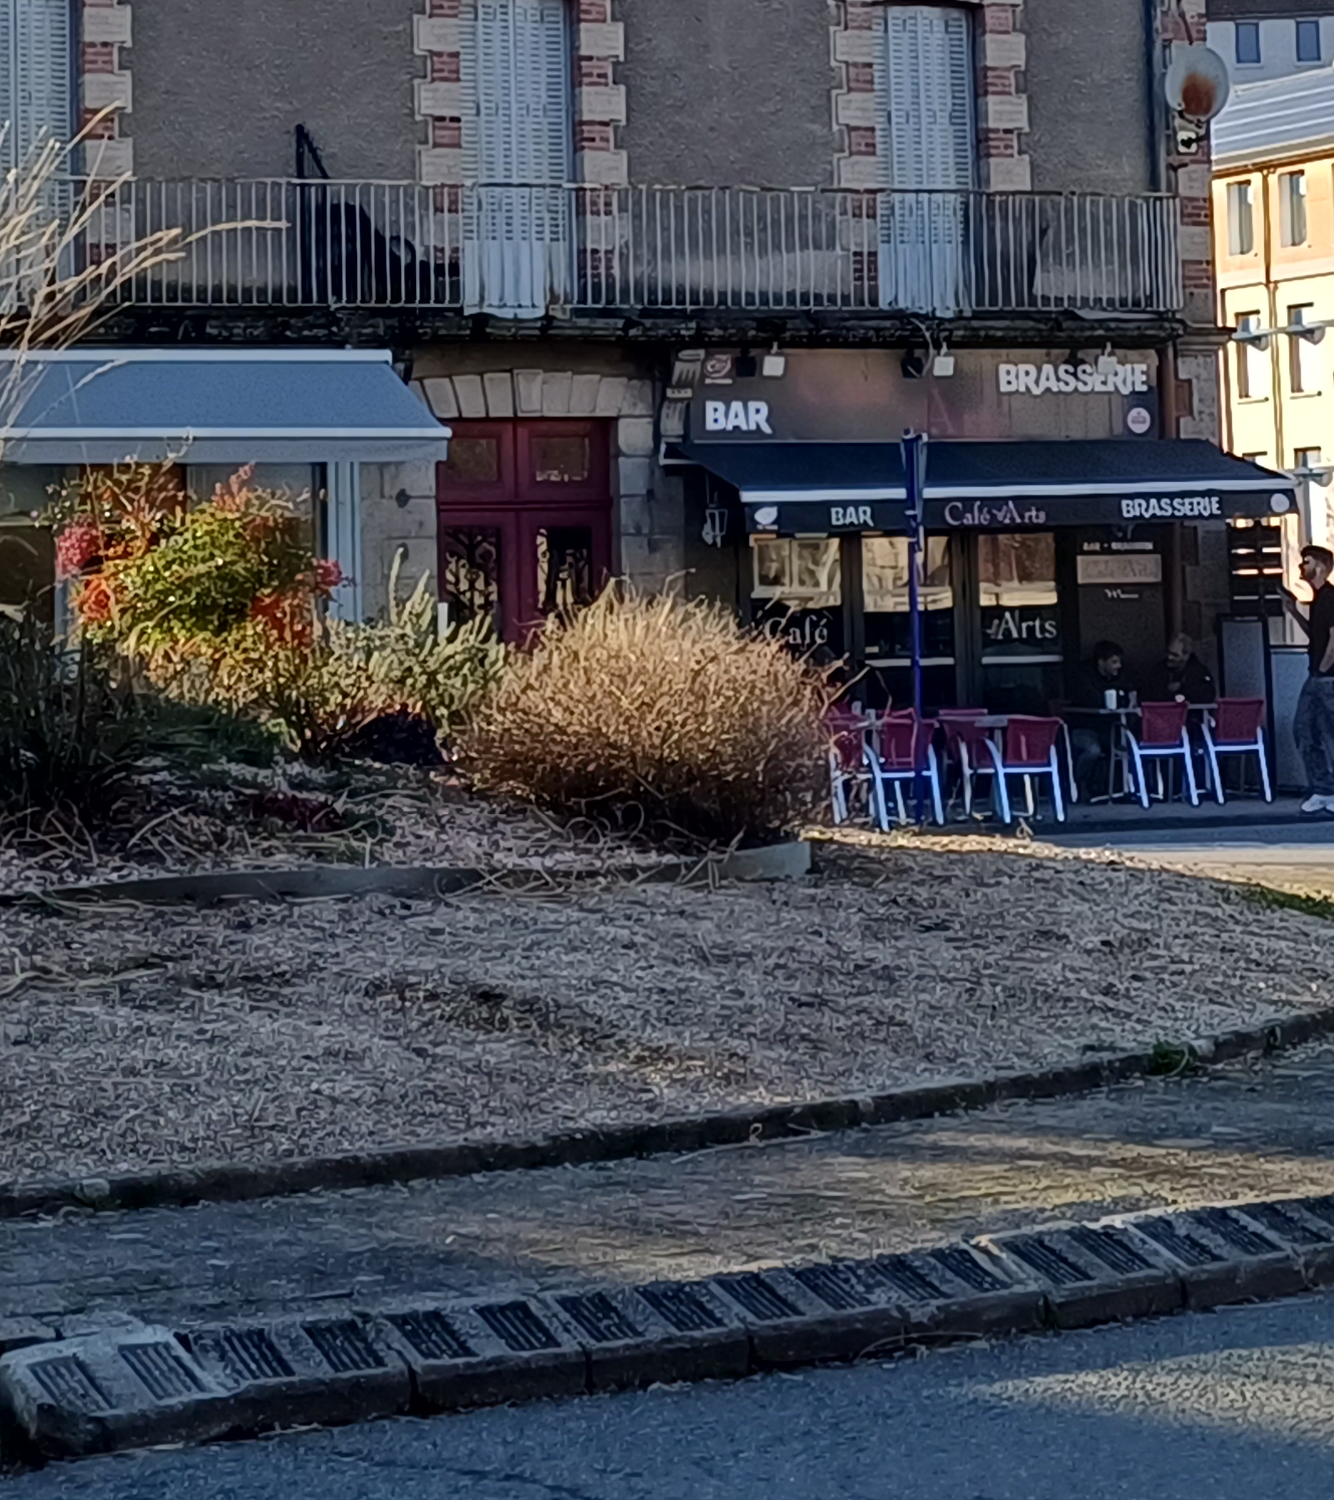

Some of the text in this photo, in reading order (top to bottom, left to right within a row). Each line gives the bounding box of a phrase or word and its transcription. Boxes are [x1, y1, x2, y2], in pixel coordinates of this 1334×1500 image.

[998, 363, 1148, 395] BRASSERIE
[705, 400, 773, 434] BAR
[830, 506, 874, 527] BAR
[944, 501, 990, 526] Café
[1004, 500, 1047, 525] Arts
[1121, 496, 1221, 519] BRASSERIE
[764, 615, 828, 650] Café
[997, 610, 1058, 639] Arts
